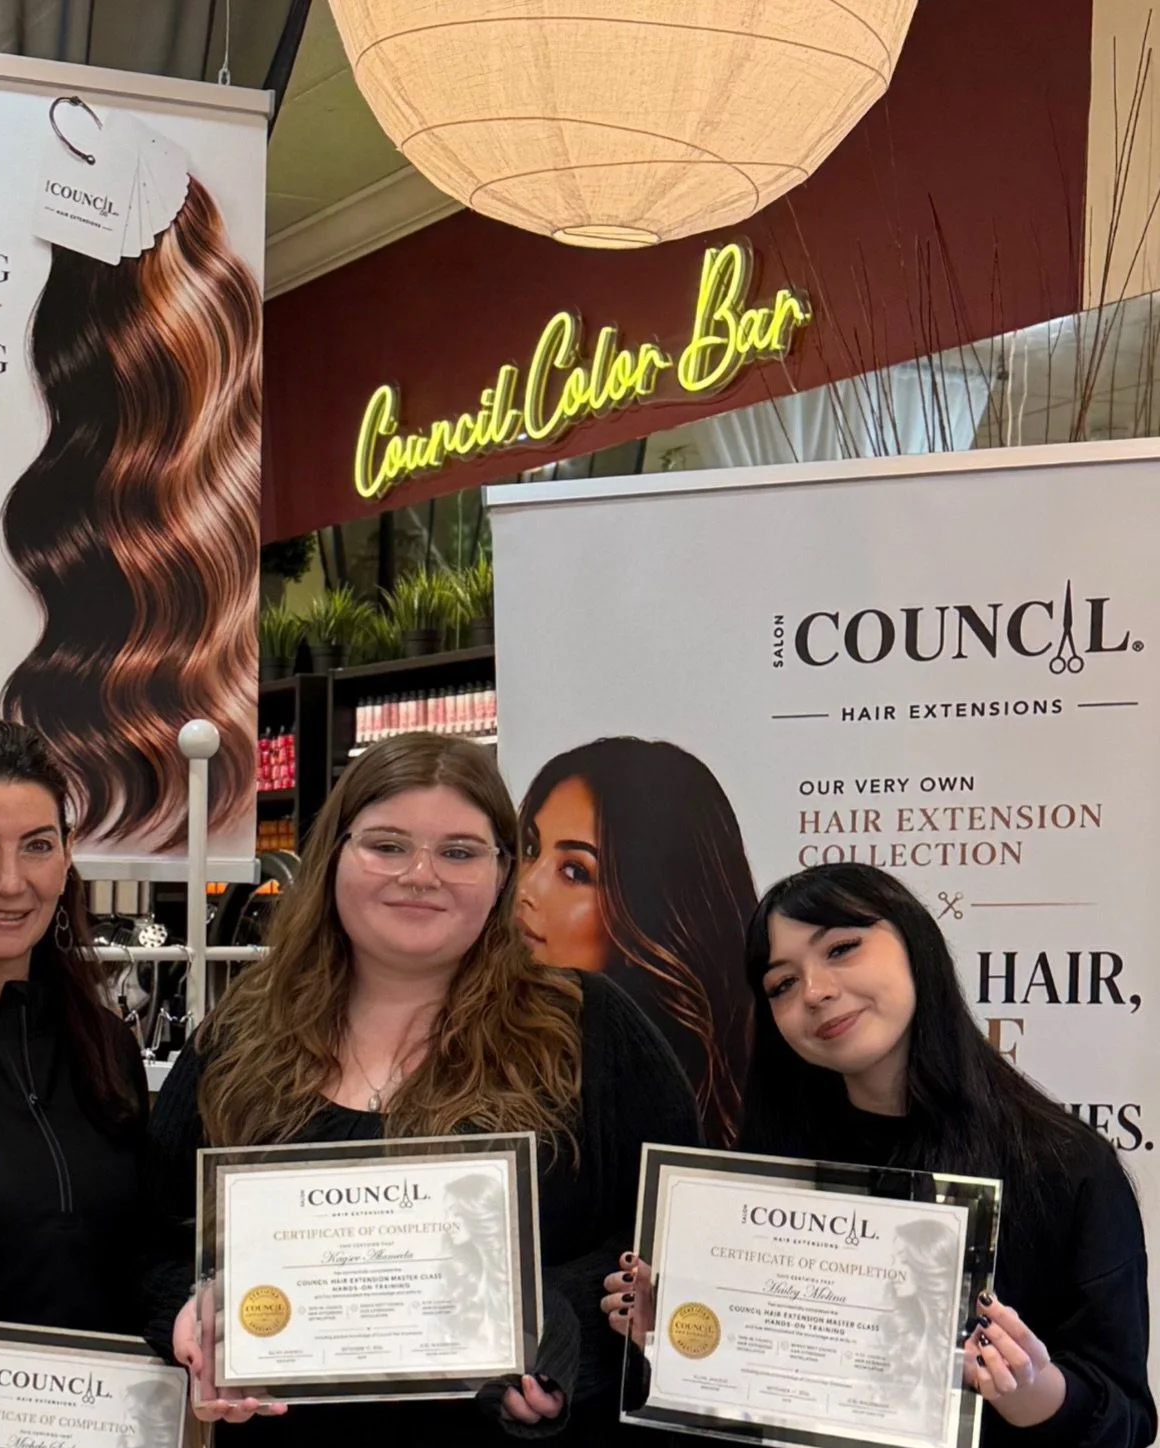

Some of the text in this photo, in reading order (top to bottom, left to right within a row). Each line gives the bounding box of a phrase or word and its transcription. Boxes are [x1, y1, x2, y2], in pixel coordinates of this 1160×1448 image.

[354, 242, 811, 500] Council Color Bar
[773, 614, 785, 668] SALON
[841, 699, 1064, 722] HAIR EXTENSIONS
[799, 776, 975, 796] OUR VERY OWN
[799, 803, 1103, 835] HAIR EXTENSION
[798, 840, 1023, 868] COLLECTION
[976, 951, 1142, 1014] HAIR,
[273, 1221, 461, 1242] CERTIFICATE OF COMPLETION
[710, 1246, 908, 1282] CERTIFICATE OF COMPLETION
[349, 1276, 390, 1284] EXTENSION
[391, 1274, 418, 1282] MASTER
[420, 1272, 443, 1280] CLASS
[763, 1310, 782, 1319] HAIR
[783, 1311, 825, 1324] EXTENSION
[826, 1317, 855, 1328] MASTER
[856, 1322, 880, 1332] CLASS
[808, 1324, 846, 1336] TRAINING
[38, 1413, 57, 1427] OF
[59, 1415, 137, 1435] COMPLETION
